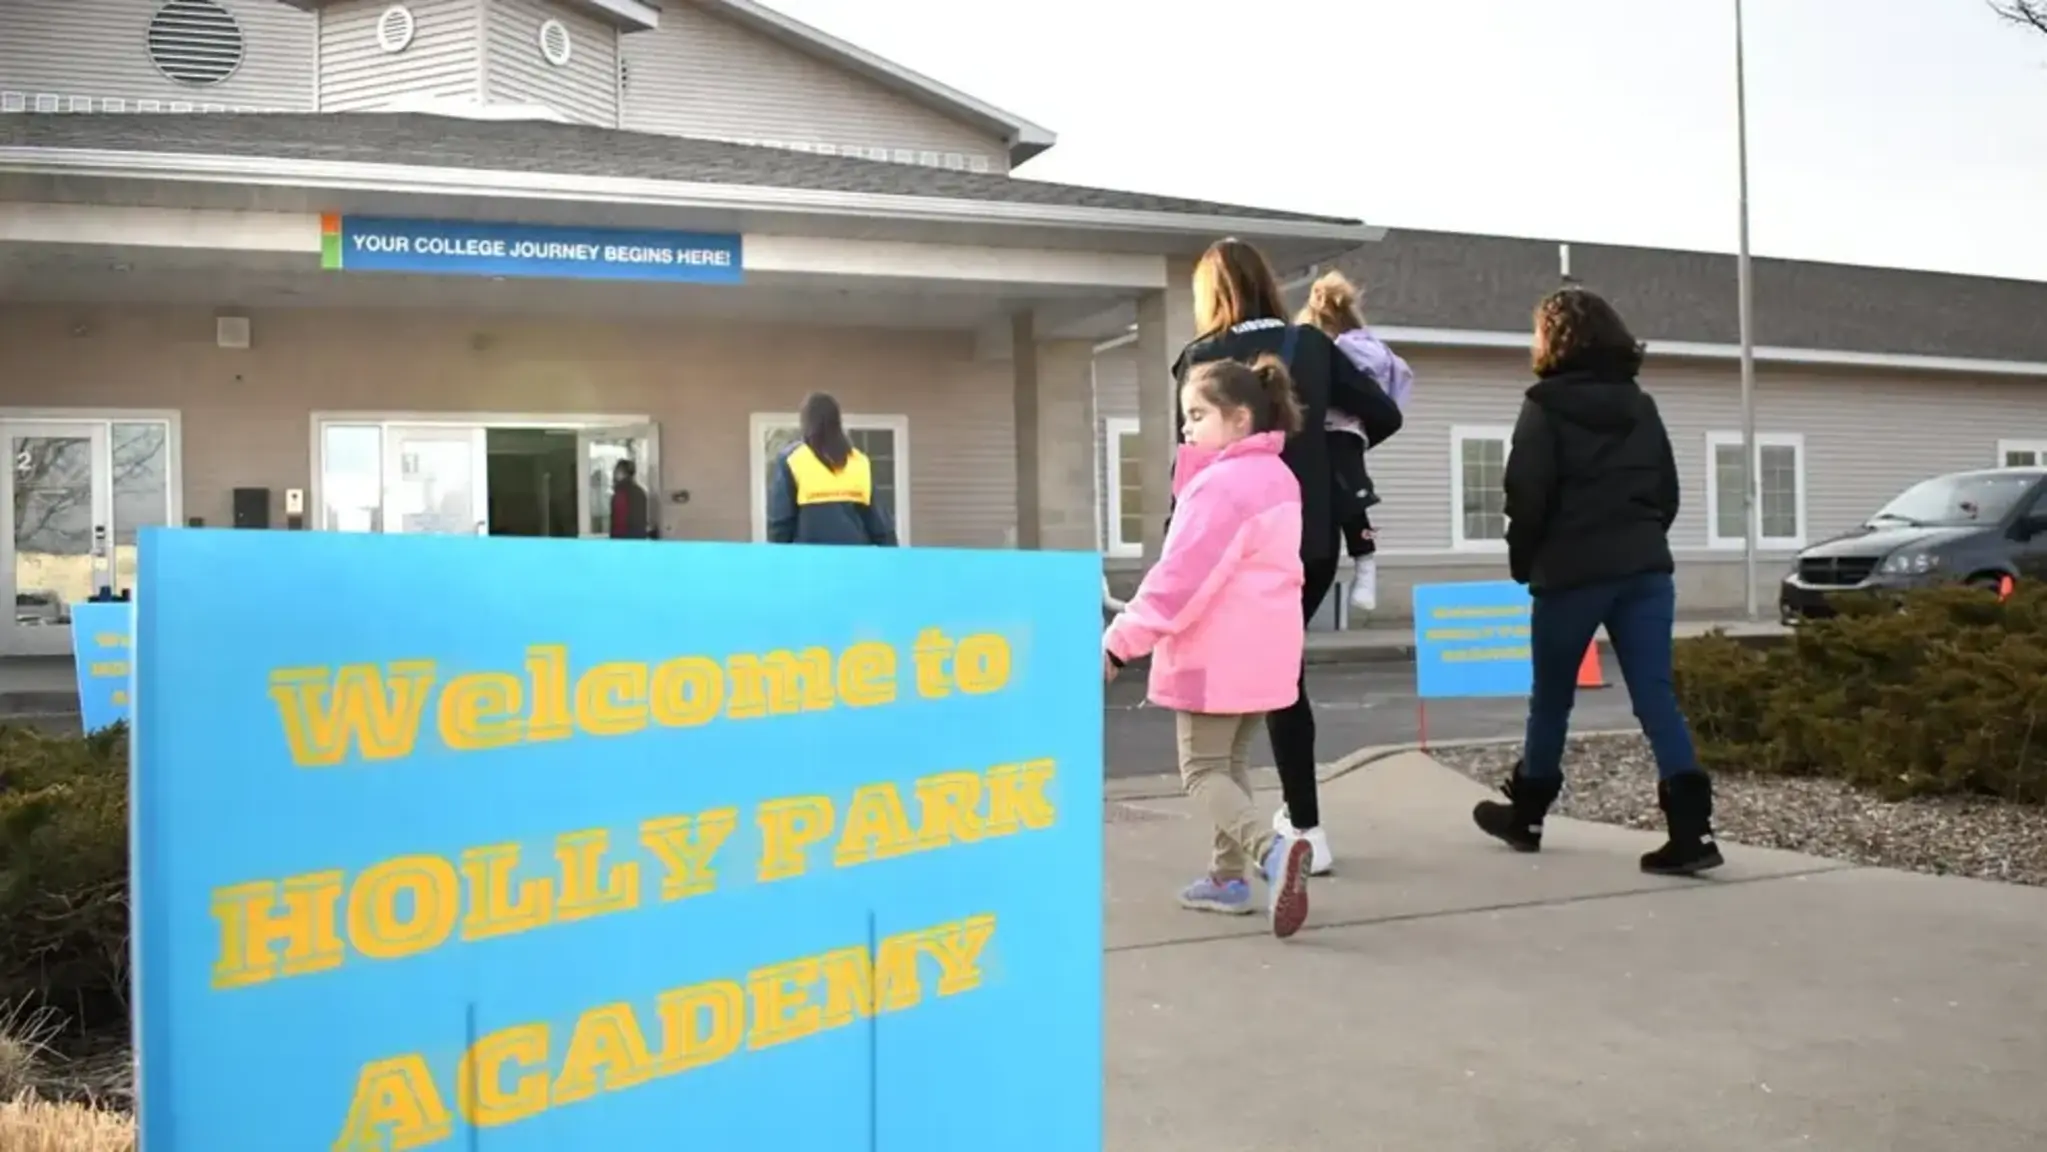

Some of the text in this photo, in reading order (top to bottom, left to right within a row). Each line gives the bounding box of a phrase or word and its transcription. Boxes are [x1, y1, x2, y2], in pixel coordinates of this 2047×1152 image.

[353, 234, 732, 267] YOUR COLLEGE JOURNEY BEGINS HERE!
[18, 450, 32, 470] 2
[269, 627, 1013, 767] Welcome to
[210, 757, 1057, 990] HOLLY PARK
[331, 912, 997, 1152] ACADEMY
